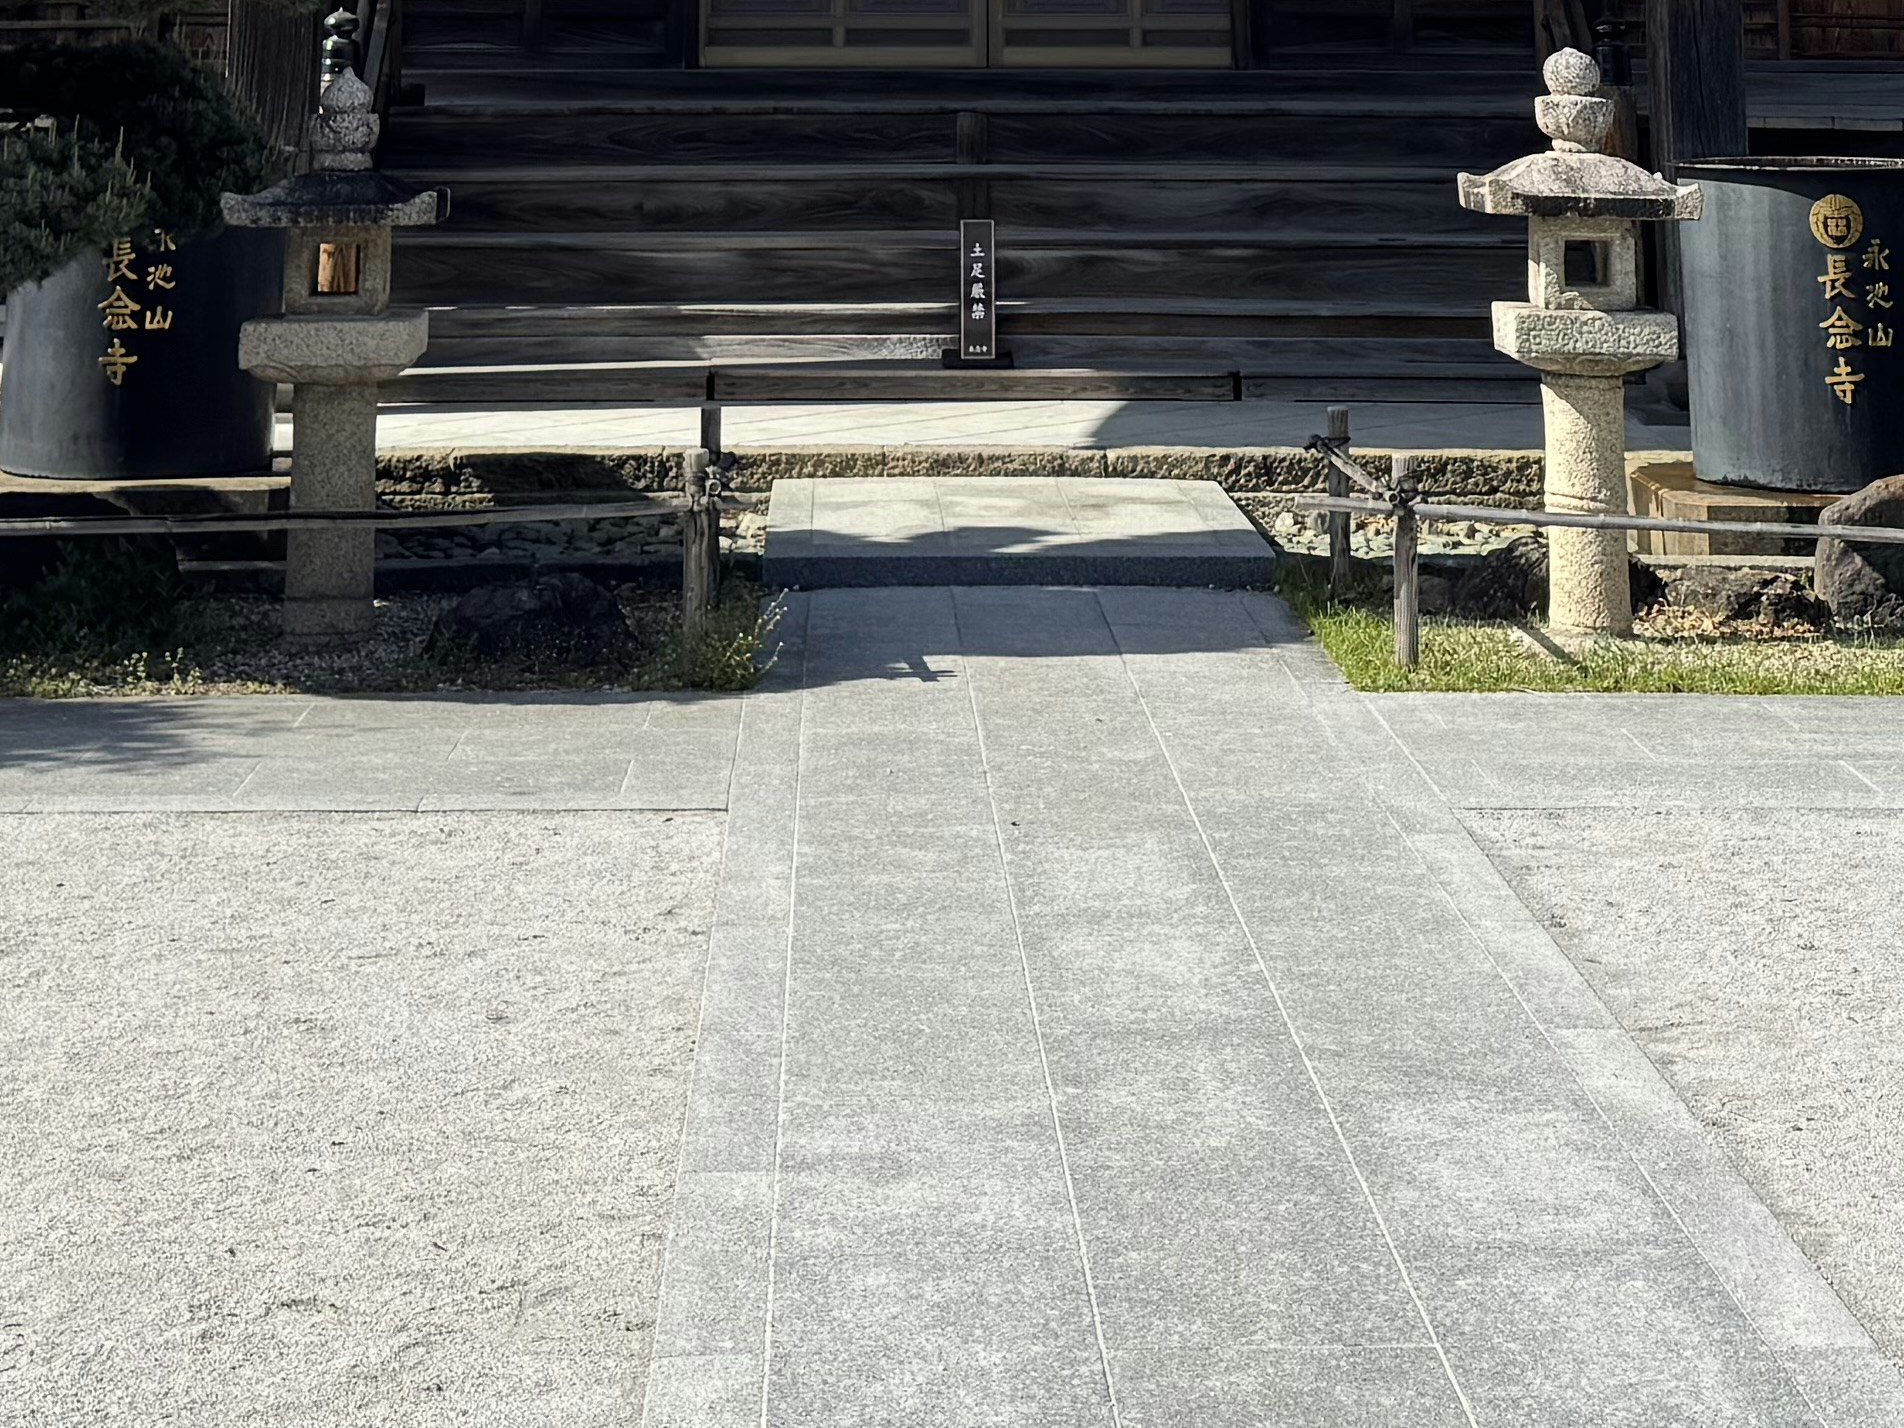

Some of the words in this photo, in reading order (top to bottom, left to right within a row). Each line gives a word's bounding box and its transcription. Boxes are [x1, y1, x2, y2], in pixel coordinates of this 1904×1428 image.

[97, 238, 141, 385] 長念寺
[1817, 254, 1865, 404] 長念寺
[1862, 239, 1893, 347] 永池山
